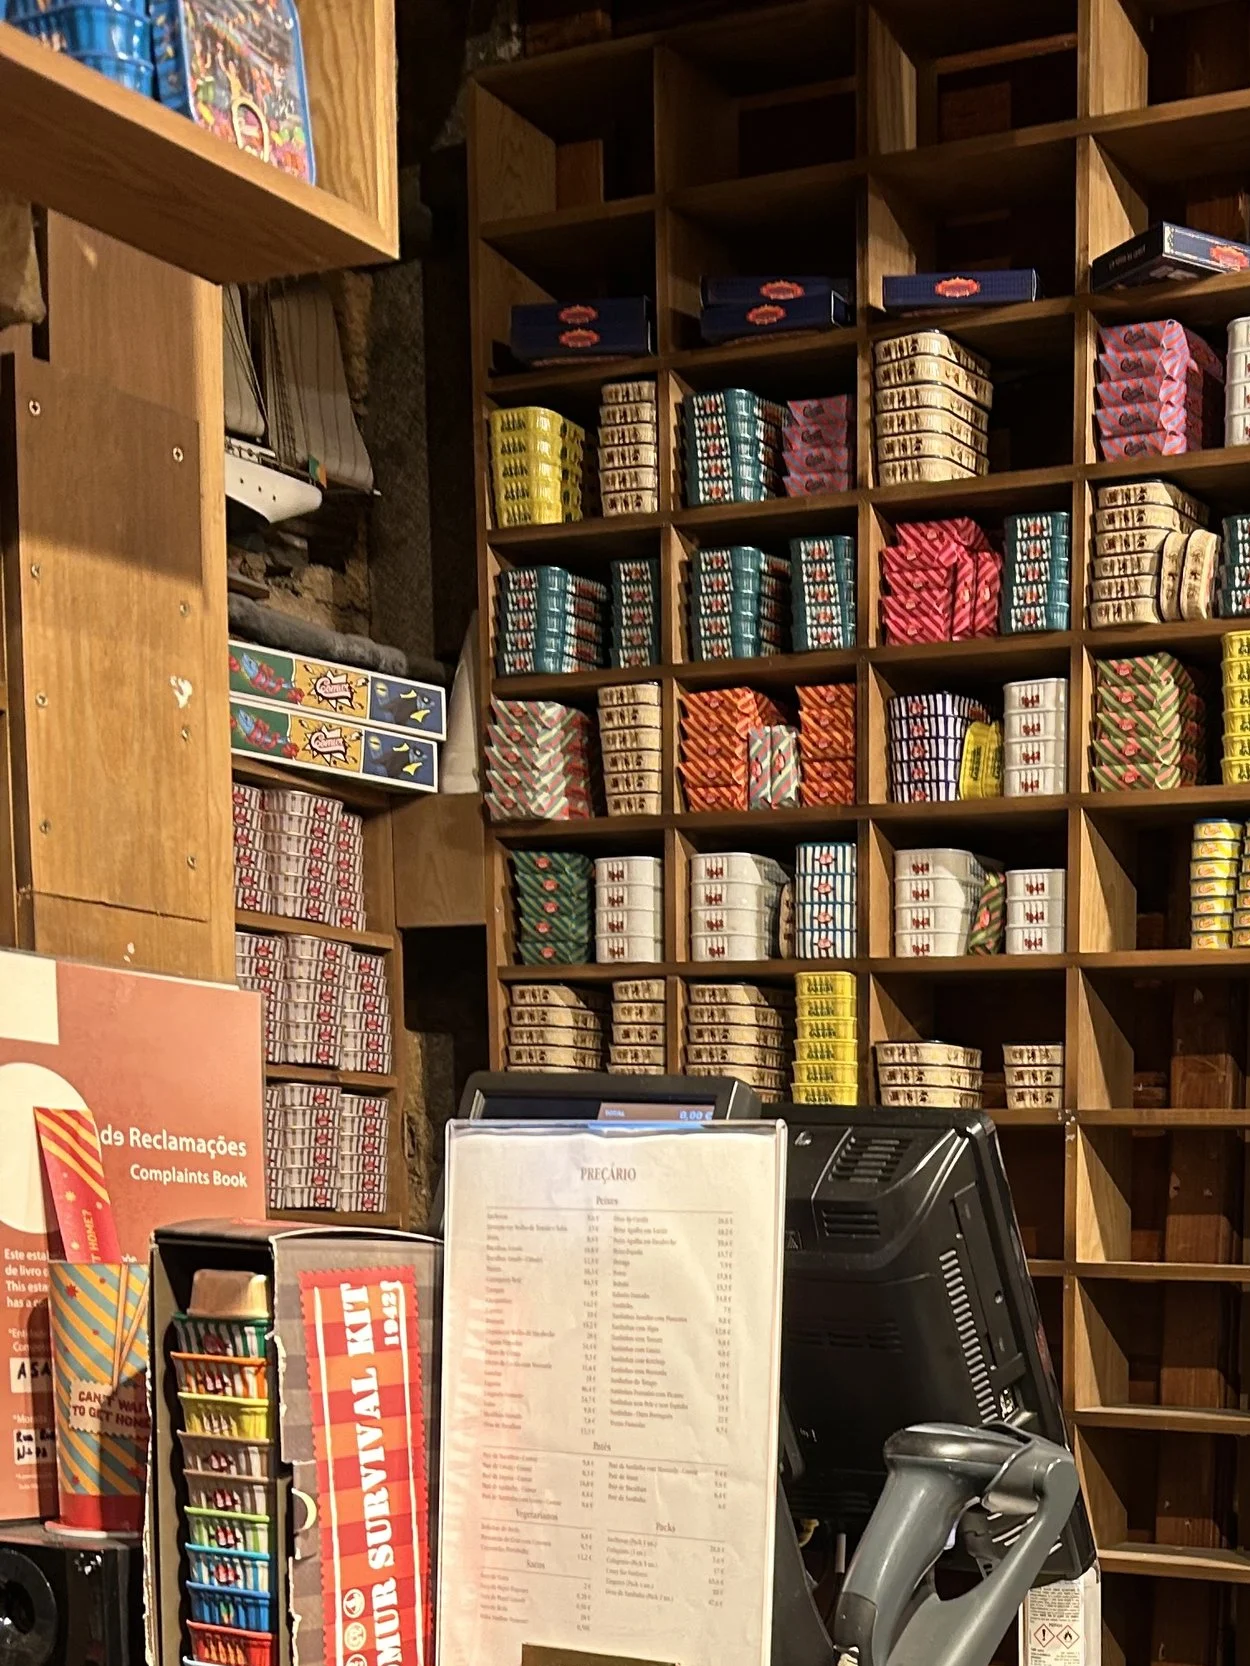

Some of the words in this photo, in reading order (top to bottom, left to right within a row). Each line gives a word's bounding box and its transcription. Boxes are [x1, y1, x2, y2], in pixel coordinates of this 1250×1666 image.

[101, 1124, 124, 1146] de
[130, 1127, 247, 1159] Reclamações
[130, 1163, 210, 1185] Complaints
[213, 1171, 247, 1188] Book
[580, 1162, 637, 1184] PREÇÁRIO
[4, 1250, 24, 1260] Este
[5, 1265, 18, 1276] de
[20, 1265, 41, 1276] livro
[6, 1280, 26, 1292] This
[7, 1296, 24, 1308] has
[340, 1283, 374, 1357] KIT
[73, 1406, 85, 1416] TO
[89, 1408, 112, 1422] GET
[350, 1366, 395, 1568] SURVIVAL
